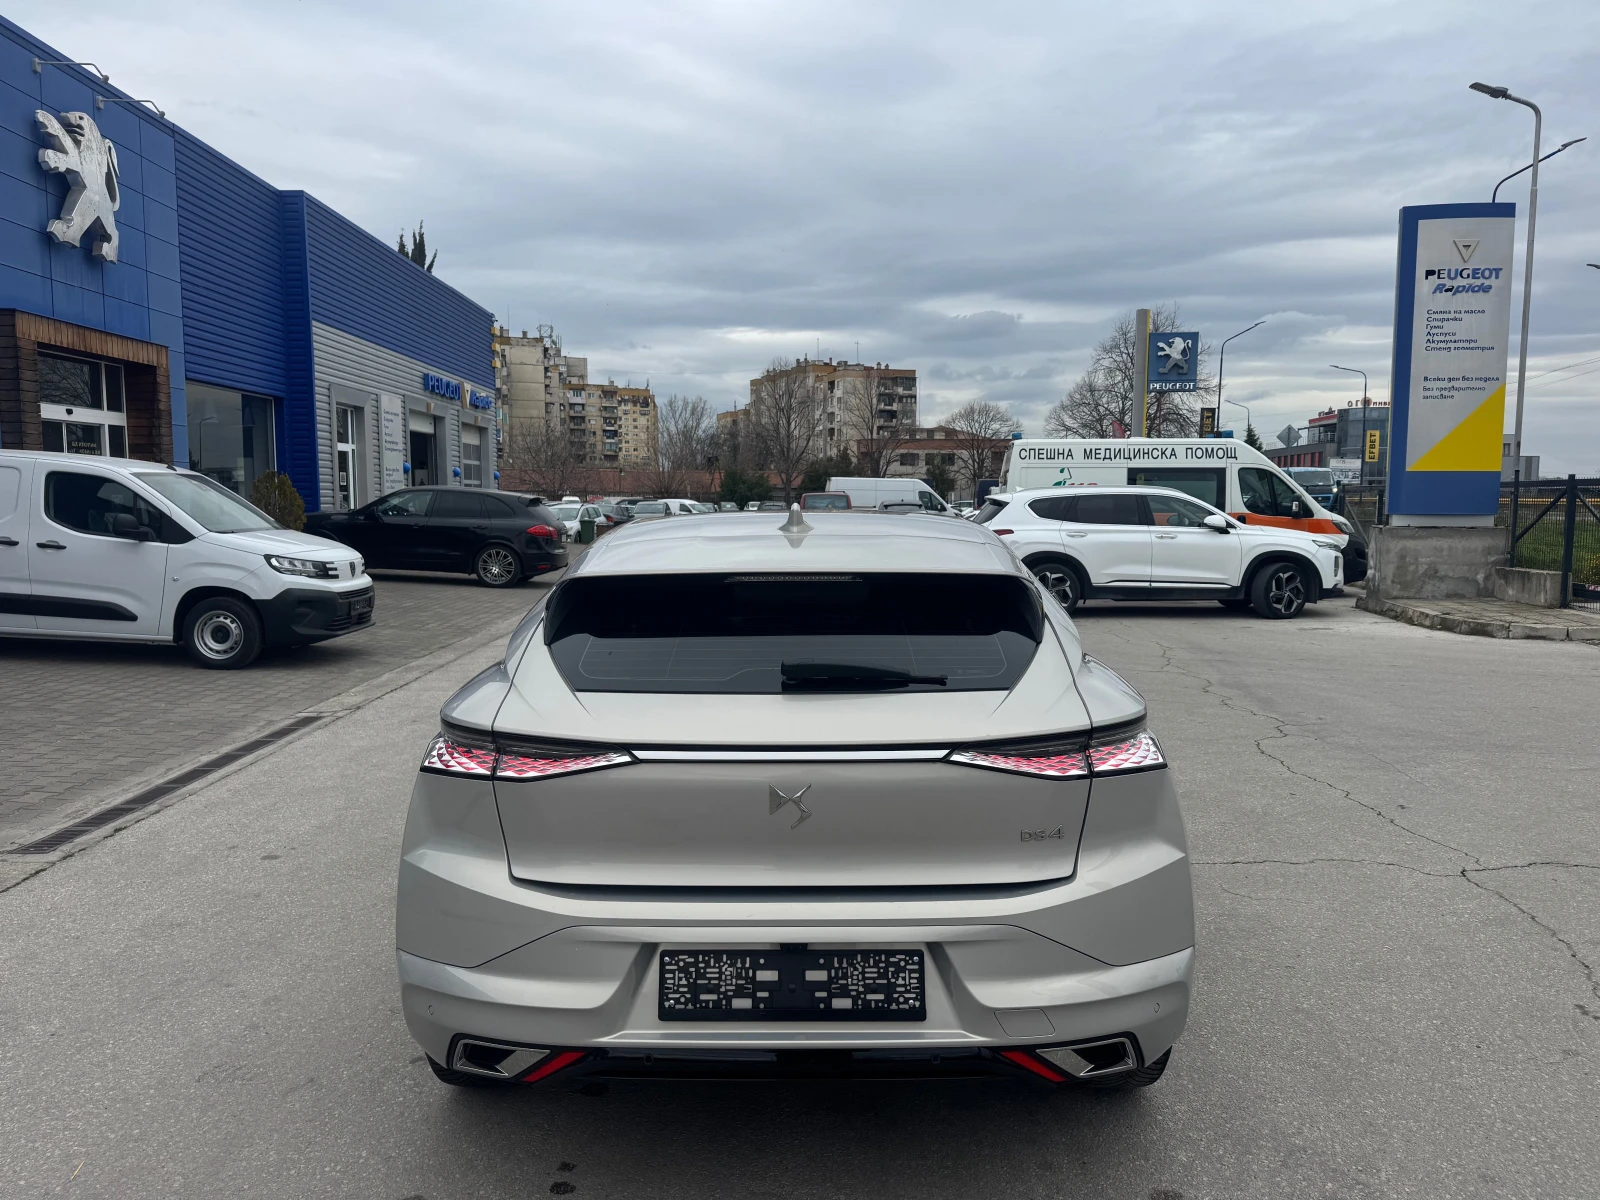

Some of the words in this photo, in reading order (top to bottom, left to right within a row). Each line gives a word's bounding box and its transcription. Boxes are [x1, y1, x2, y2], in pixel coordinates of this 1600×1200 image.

[1425, 267, 1503, 280] PEUGEOT
[1432, 282, 1493, 296] Rapide
[1425, 323, 1444, 331] Гуми
[1149, 382, 1196, 390] PEUGEOT
[1368, 432, 1377, 460] EFBET
[1018, 447, 1074, 461] СПЕШНА
[1083, 447, 1178, 462] МЕДИЦИНСКА
[1185, 446, 1238, 461] ПОМОЩ
